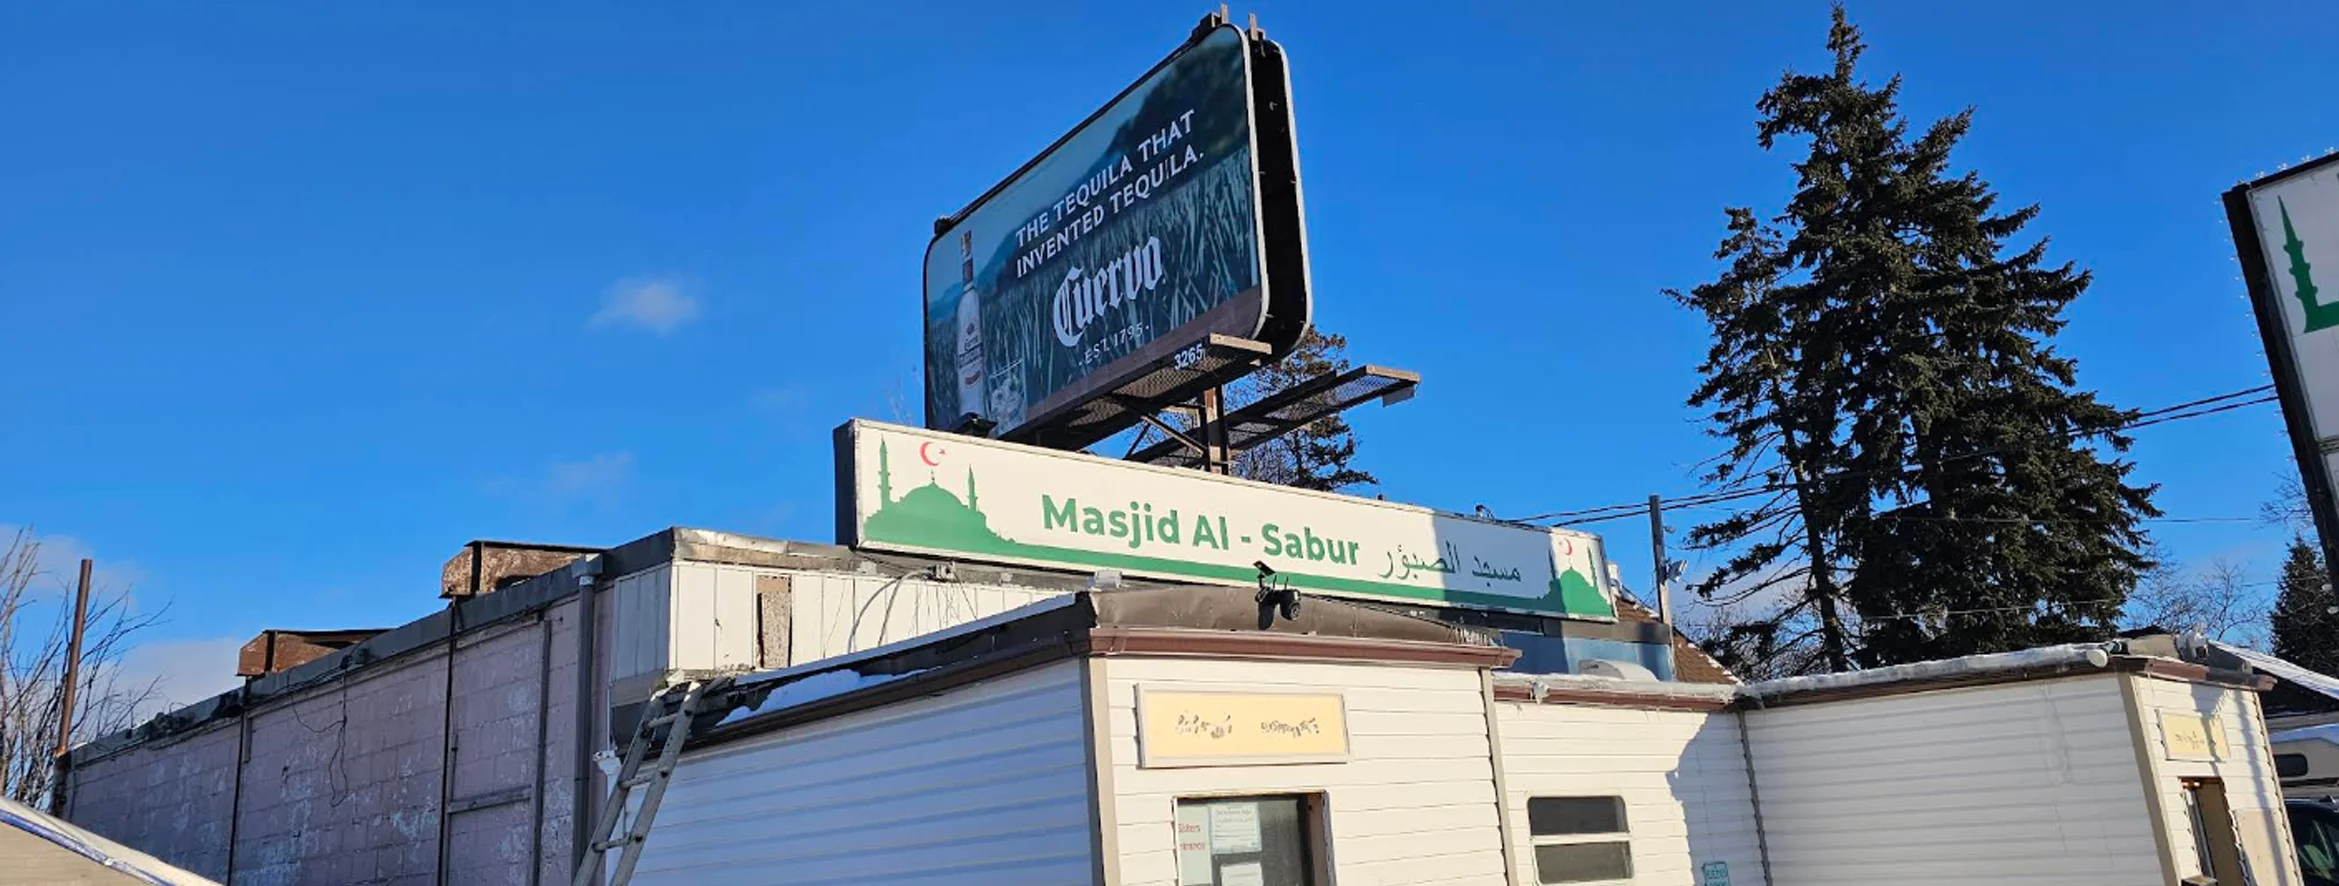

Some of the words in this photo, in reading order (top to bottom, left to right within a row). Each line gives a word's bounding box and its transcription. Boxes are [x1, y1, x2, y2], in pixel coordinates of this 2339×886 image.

[1015, 212, 1050, 247] THE
[1053, 154, 1133, 222] TEQUILA
[1137, 109, 1195, 162] THAT
[1016, 205, 1104, 278] INVENTED
[1109, 144, 1204, 214] TEQUILA.
[1053, 236, 1163, 347] Cuervo
[1174, 344, 1204, 370] 3265
[1042, 494, 1181, 549] Masjid
[1192, 513, 1230, 550] Al
[1261, 523, 1360, 565] Sabur
[1472, 555, 1521, 587] مسجد
